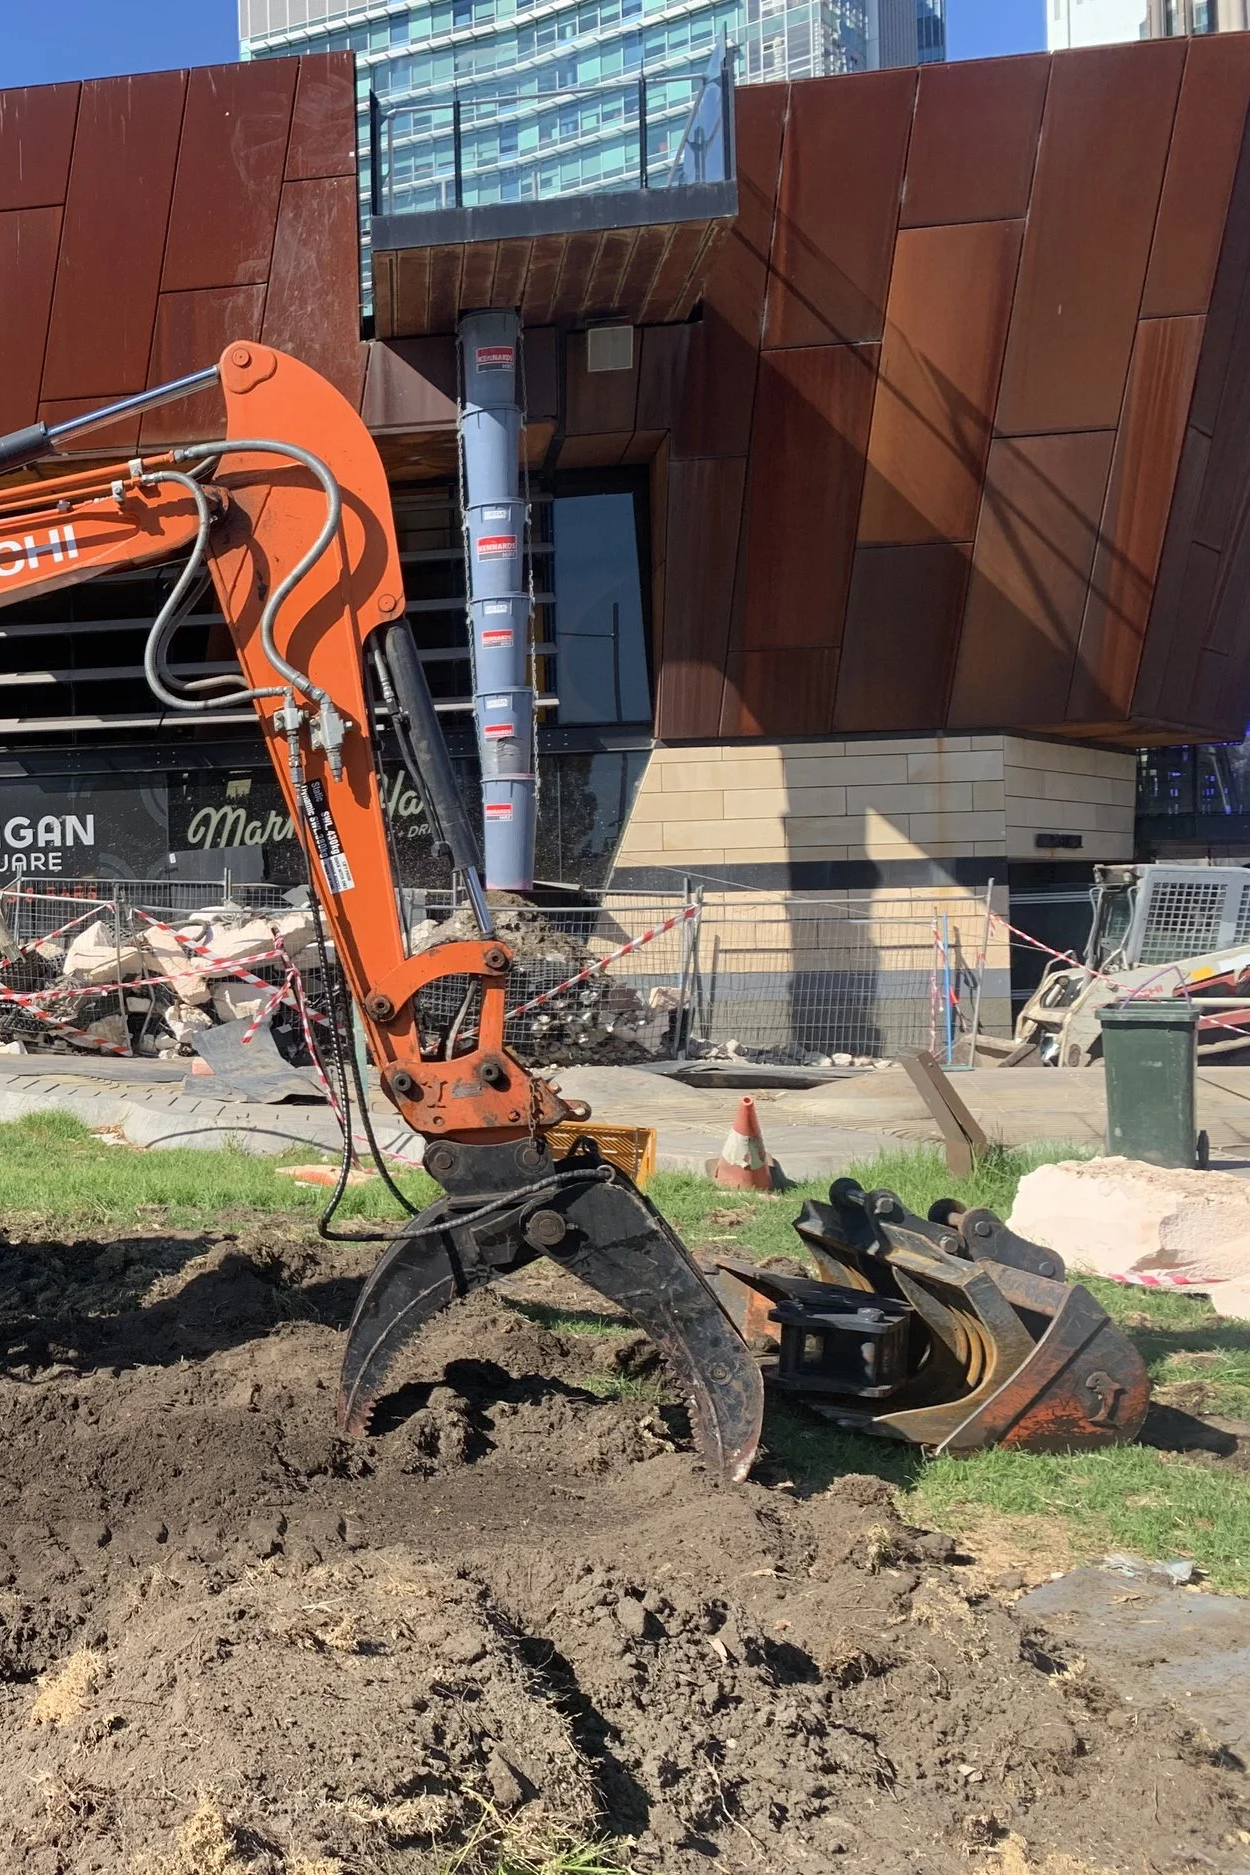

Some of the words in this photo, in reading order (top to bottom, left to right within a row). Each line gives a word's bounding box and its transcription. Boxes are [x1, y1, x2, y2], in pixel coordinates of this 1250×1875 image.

[478, 543, 516, 552] KENNARDS
[300, 784, 316, 817] Dynamic
[311, 781, 323, 802] Static
